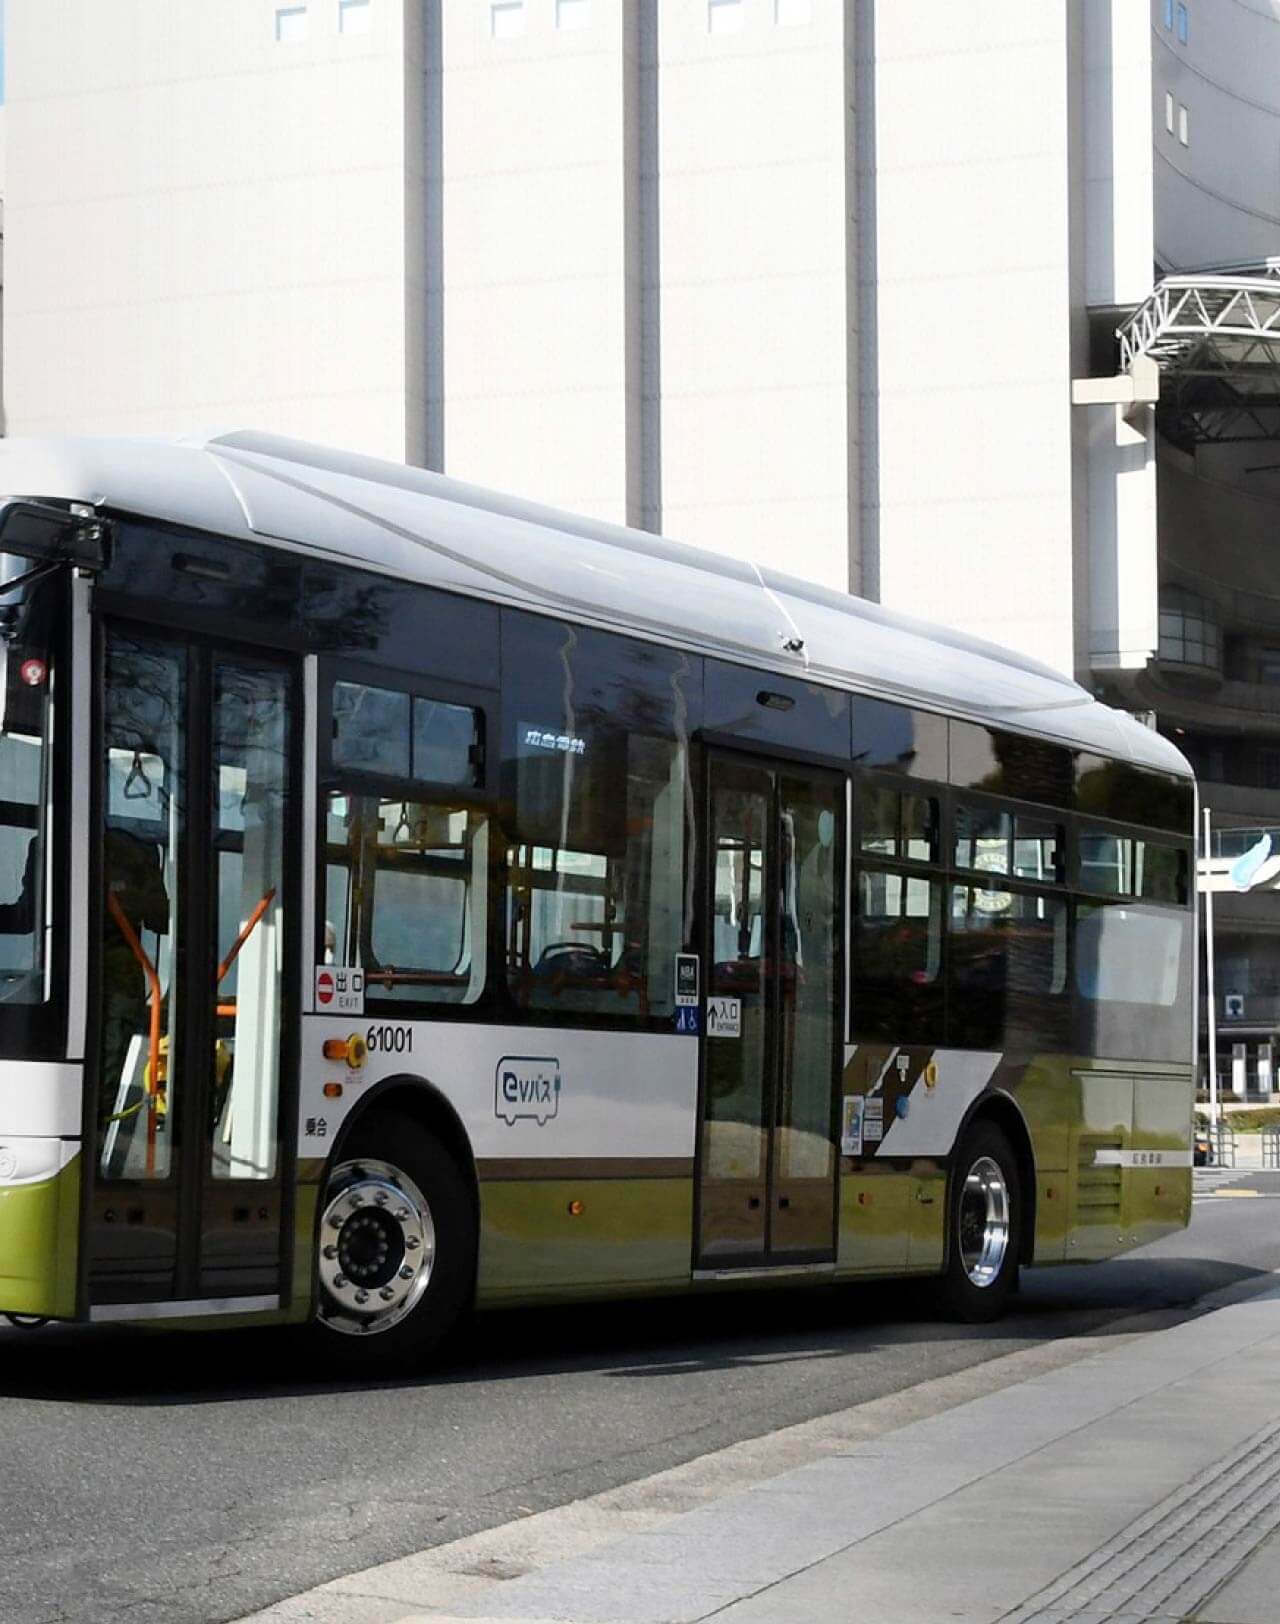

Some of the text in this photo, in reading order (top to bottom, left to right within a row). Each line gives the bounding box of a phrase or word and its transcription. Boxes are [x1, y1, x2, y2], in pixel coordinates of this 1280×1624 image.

[336, 972, 362, 992] 出口
[338, 997, 359, 1009] EXIT
[720, 1001, 737, 1019] 入口
[366, 1025, 413, 1053] 61001
